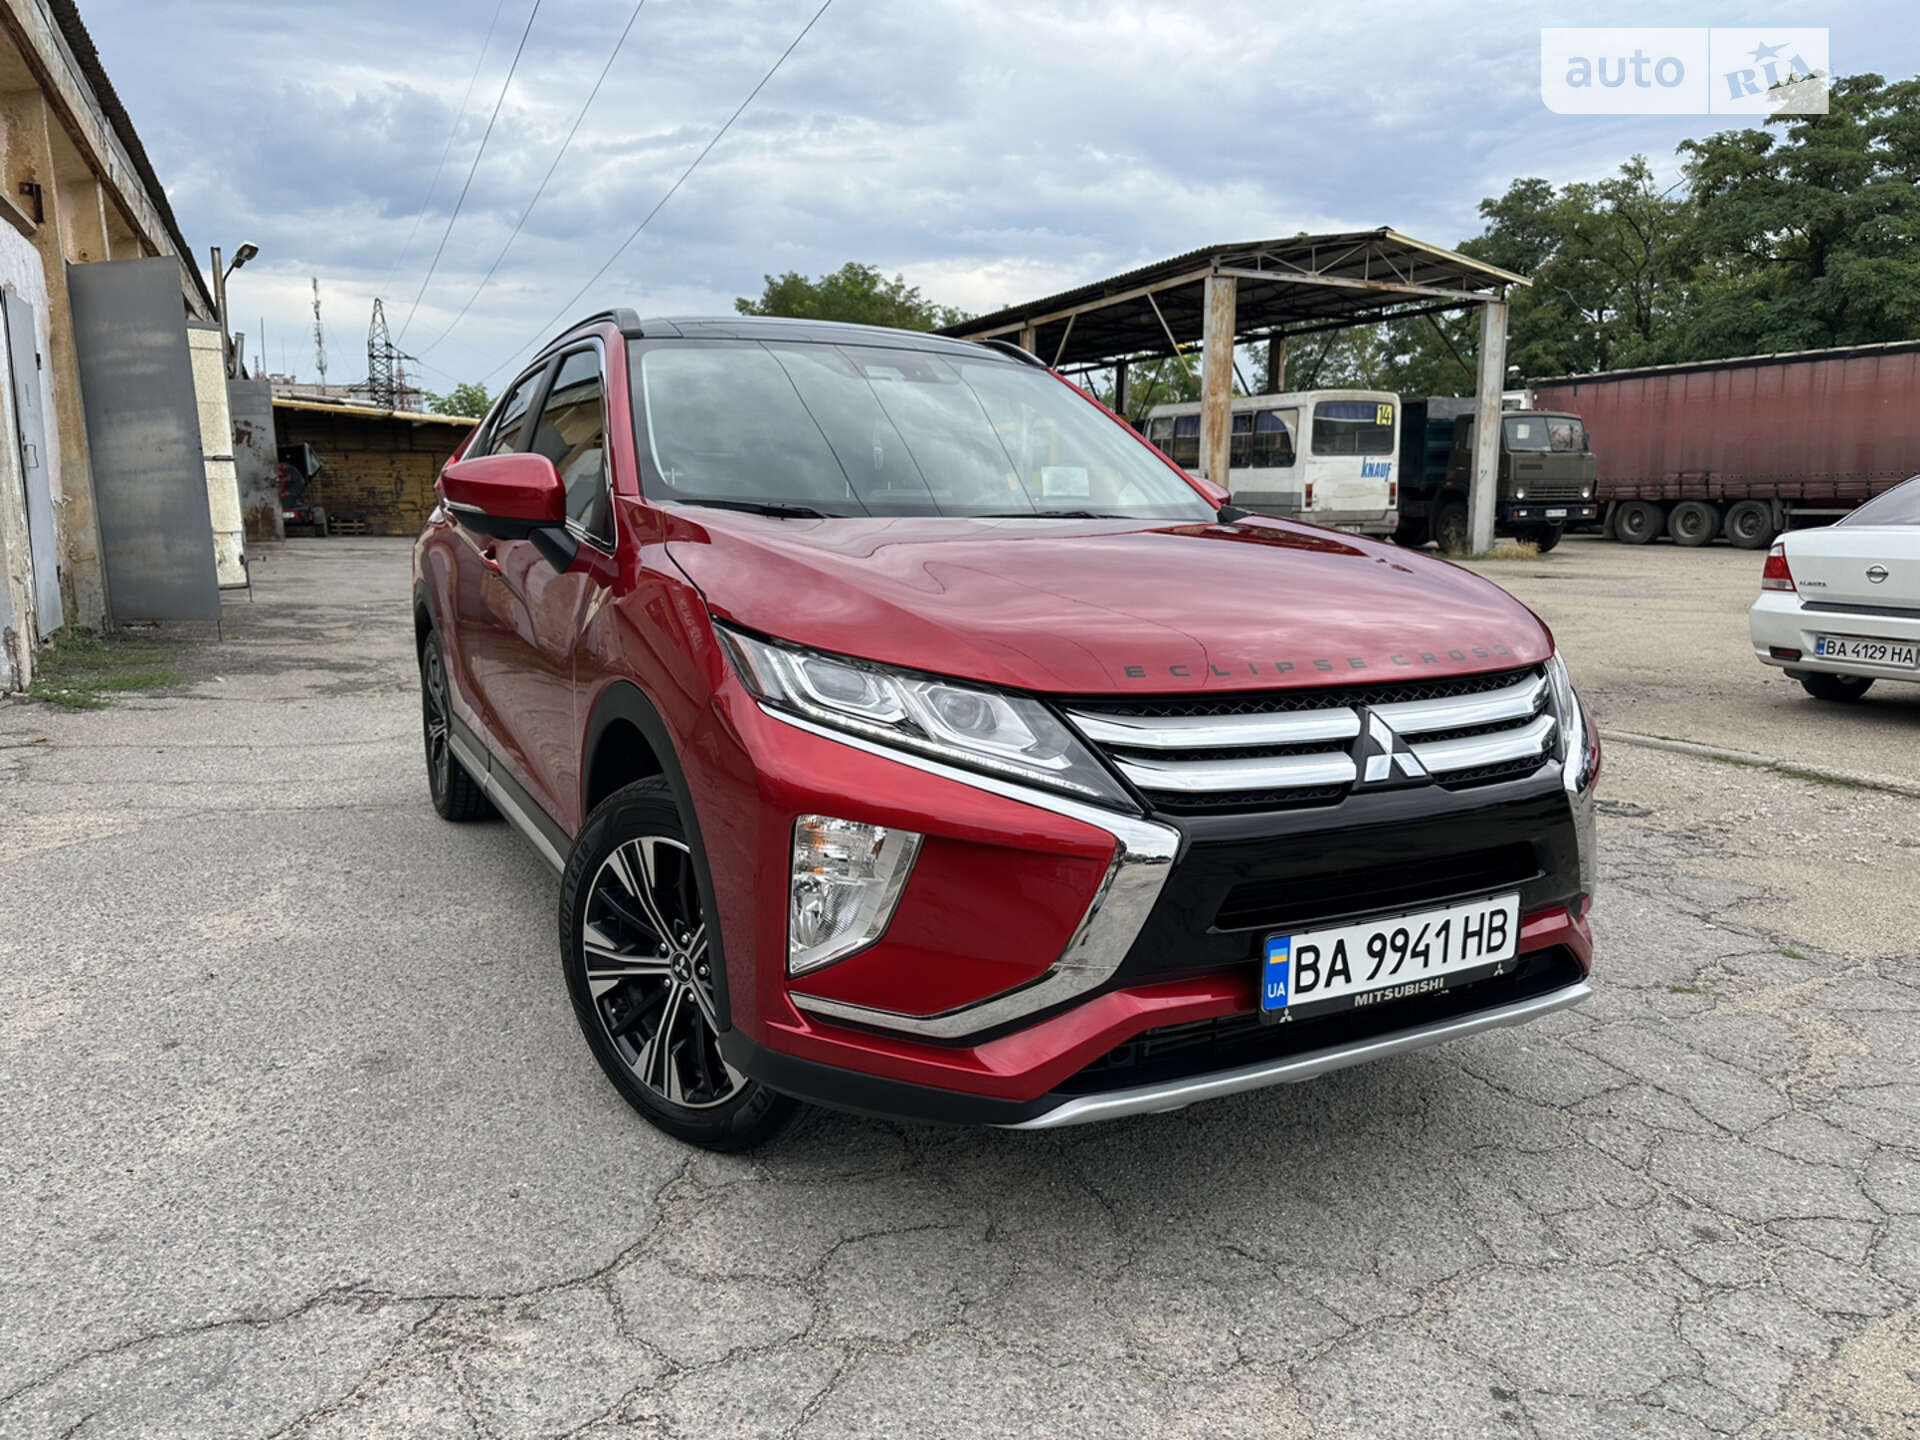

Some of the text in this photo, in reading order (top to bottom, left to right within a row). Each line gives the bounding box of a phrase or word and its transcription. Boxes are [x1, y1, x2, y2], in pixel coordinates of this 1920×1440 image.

[1379, 406, 1391, 424] 14
[1361, 456, 1392, 482] KNAUF
[1124, 643, 1510, 679] ECLIPSE CROSS
[1826, 640, 1914, 663] BA 4129 HA
[1294, 908, 1508, 995] BA 9941 HB
[1267, 982, 1286, 999] UA
[1354, 977, 1445, 1008] MITSUBISHI
